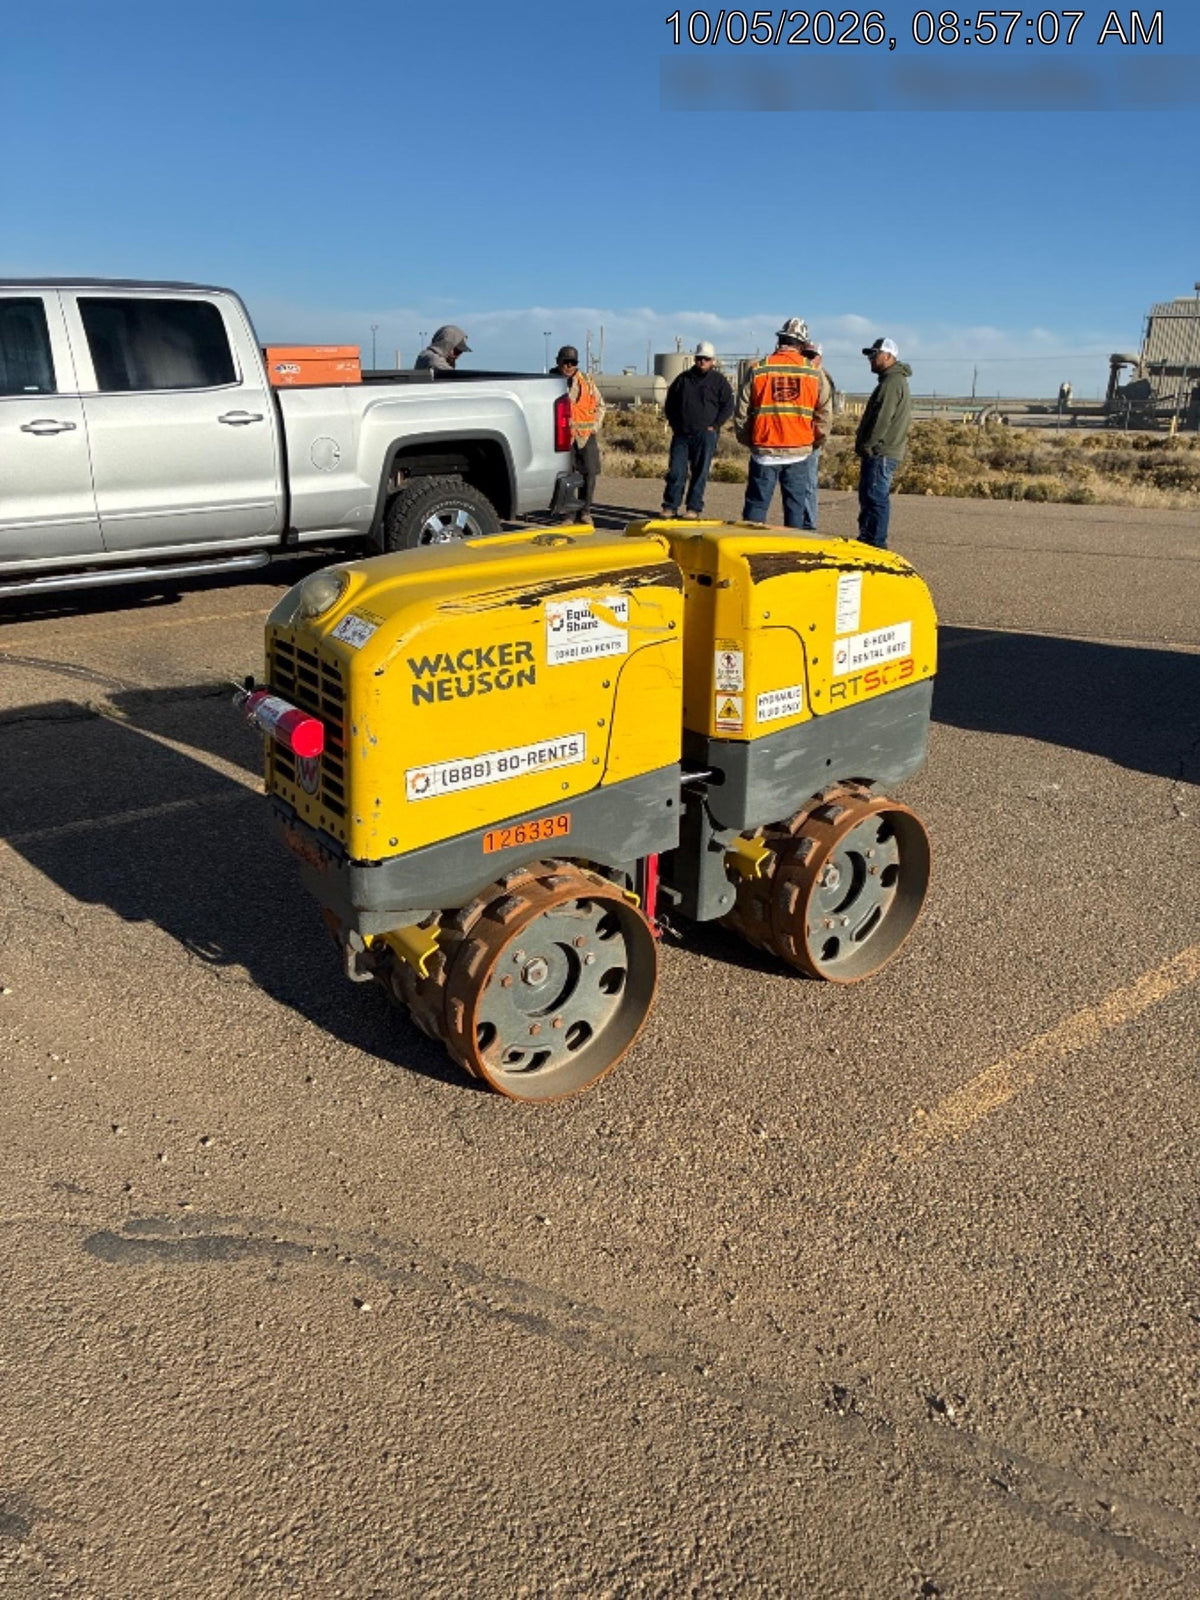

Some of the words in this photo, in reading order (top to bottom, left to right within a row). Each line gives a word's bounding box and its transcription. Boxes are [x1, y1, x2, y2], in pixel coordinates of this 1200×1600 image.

[566, 620, 598, 632] Share
[407, 641, 535, 680] WACKER
[412, 664, 536, 706] NEUSON
[442, 760, 491, 786] (888)
[497, 742, 579, 773] 80-RENTS
[486, 815, 569, 851] 126339
